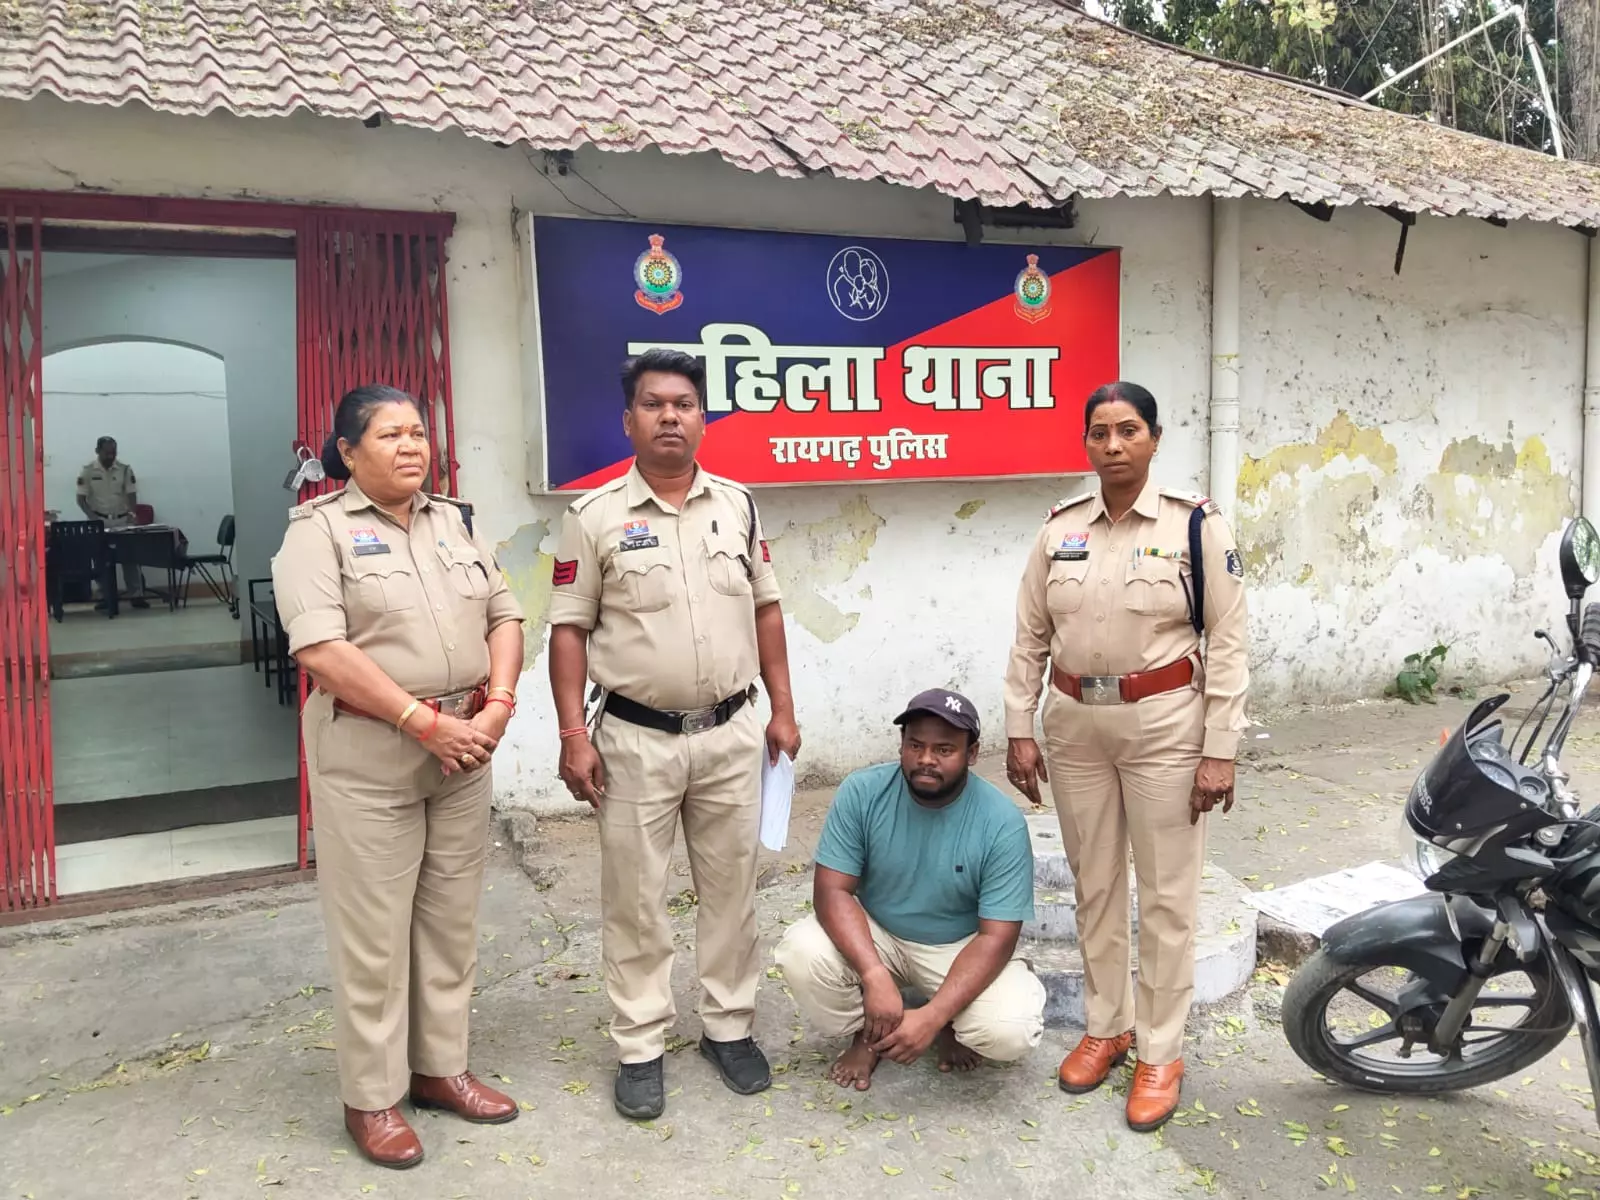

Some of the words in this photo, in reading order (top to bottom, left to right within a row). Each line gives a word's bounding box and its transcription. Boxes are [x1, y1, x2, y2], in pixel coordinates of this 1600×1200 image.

[628, 323, 884, 412] हिला
[903, 345, 1059, 409] थाना
[769, 435, 862, 469] रायगढ़
[866, 428, 948, 470] पुलिस
